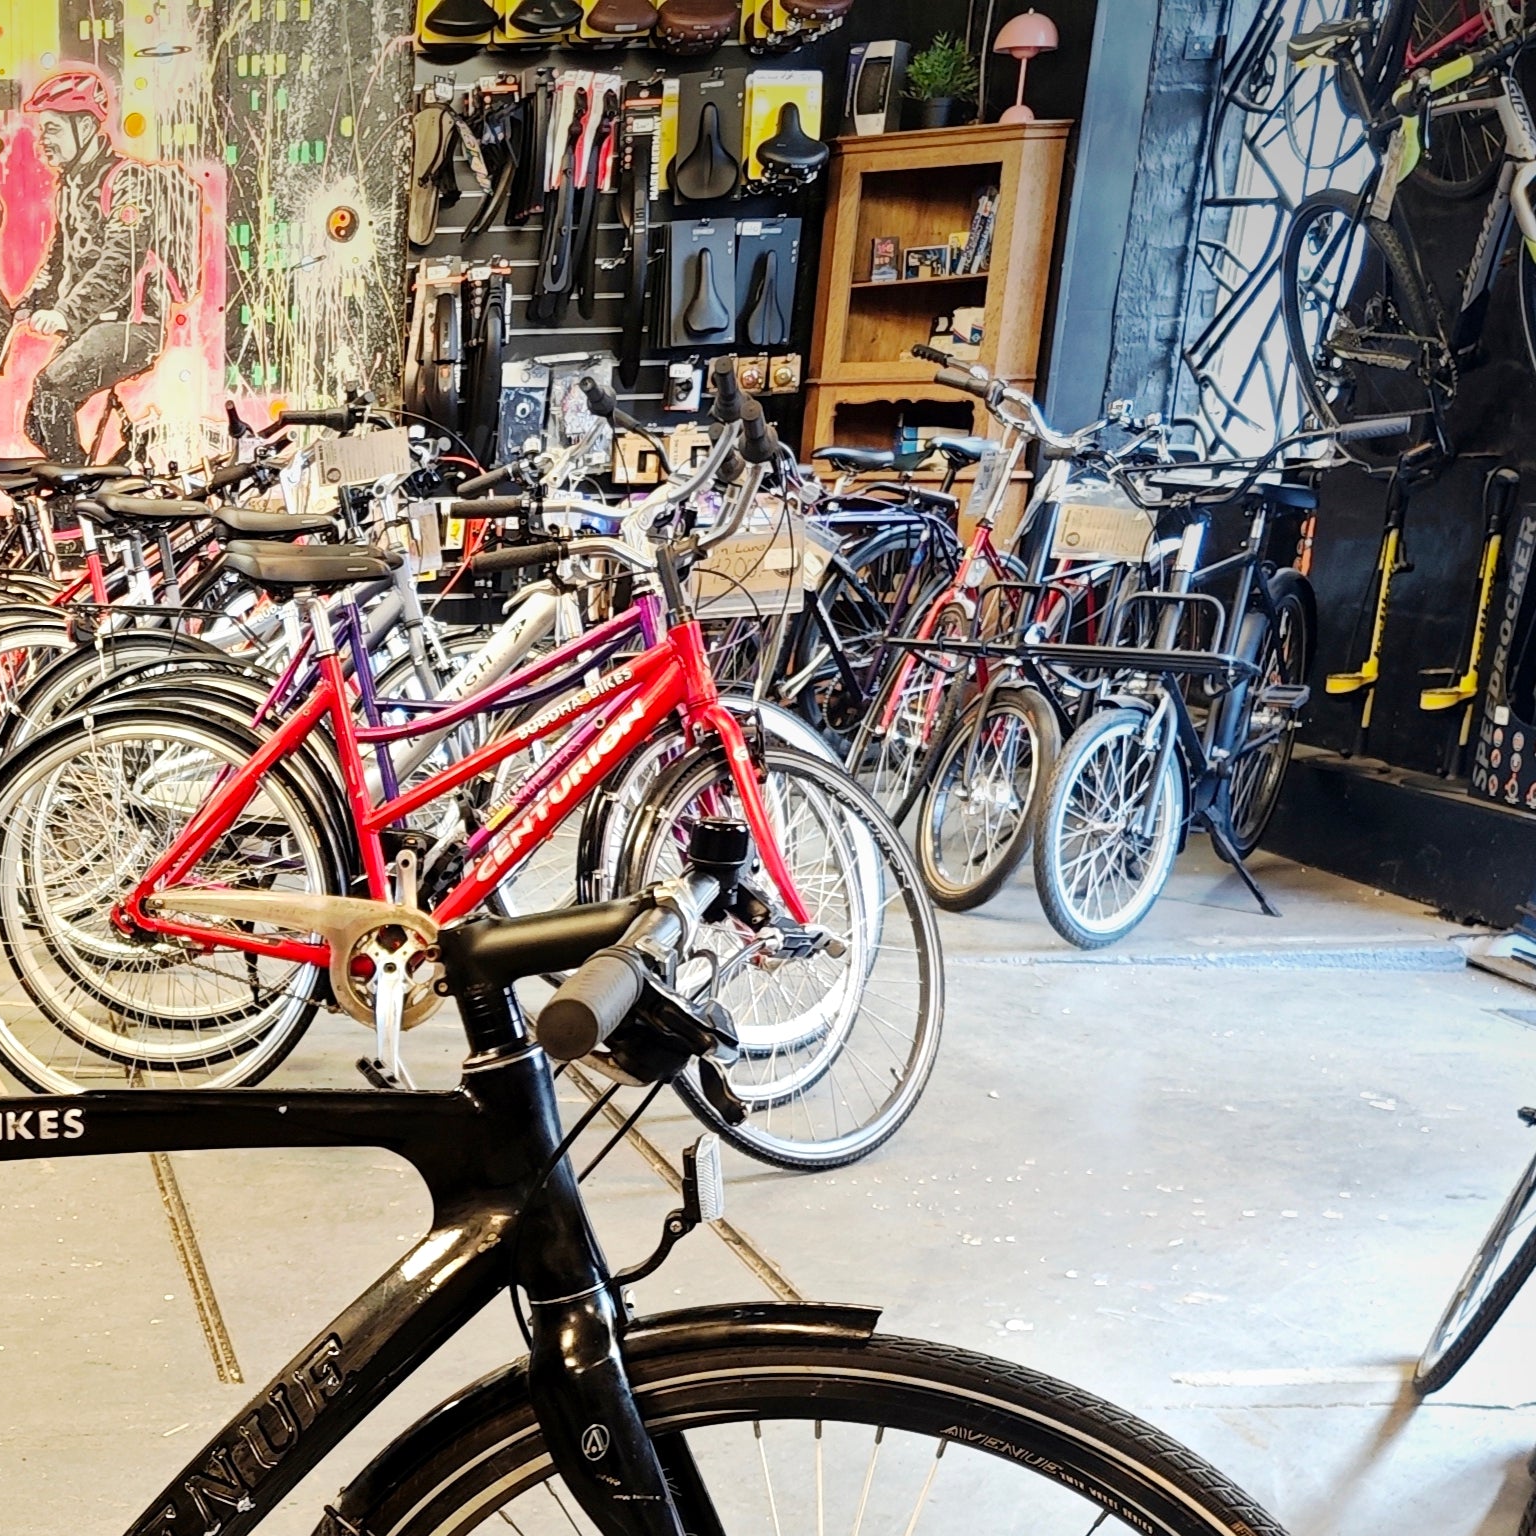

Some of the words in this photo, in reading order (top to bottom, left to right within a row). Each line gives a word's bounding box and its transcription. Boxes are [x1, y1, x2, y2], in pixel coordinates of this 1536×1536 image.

[517, 693, 586, 740] BUDDHA
[588, 668, 634, 700] BIKES
[476, 698, 645, 882] CENTURION
[825, 783, 912, 889] CENTURION
[940, 1425, 1064, 1476] AVENUE
[1122, 1502, 1154, 1535] SERIES
